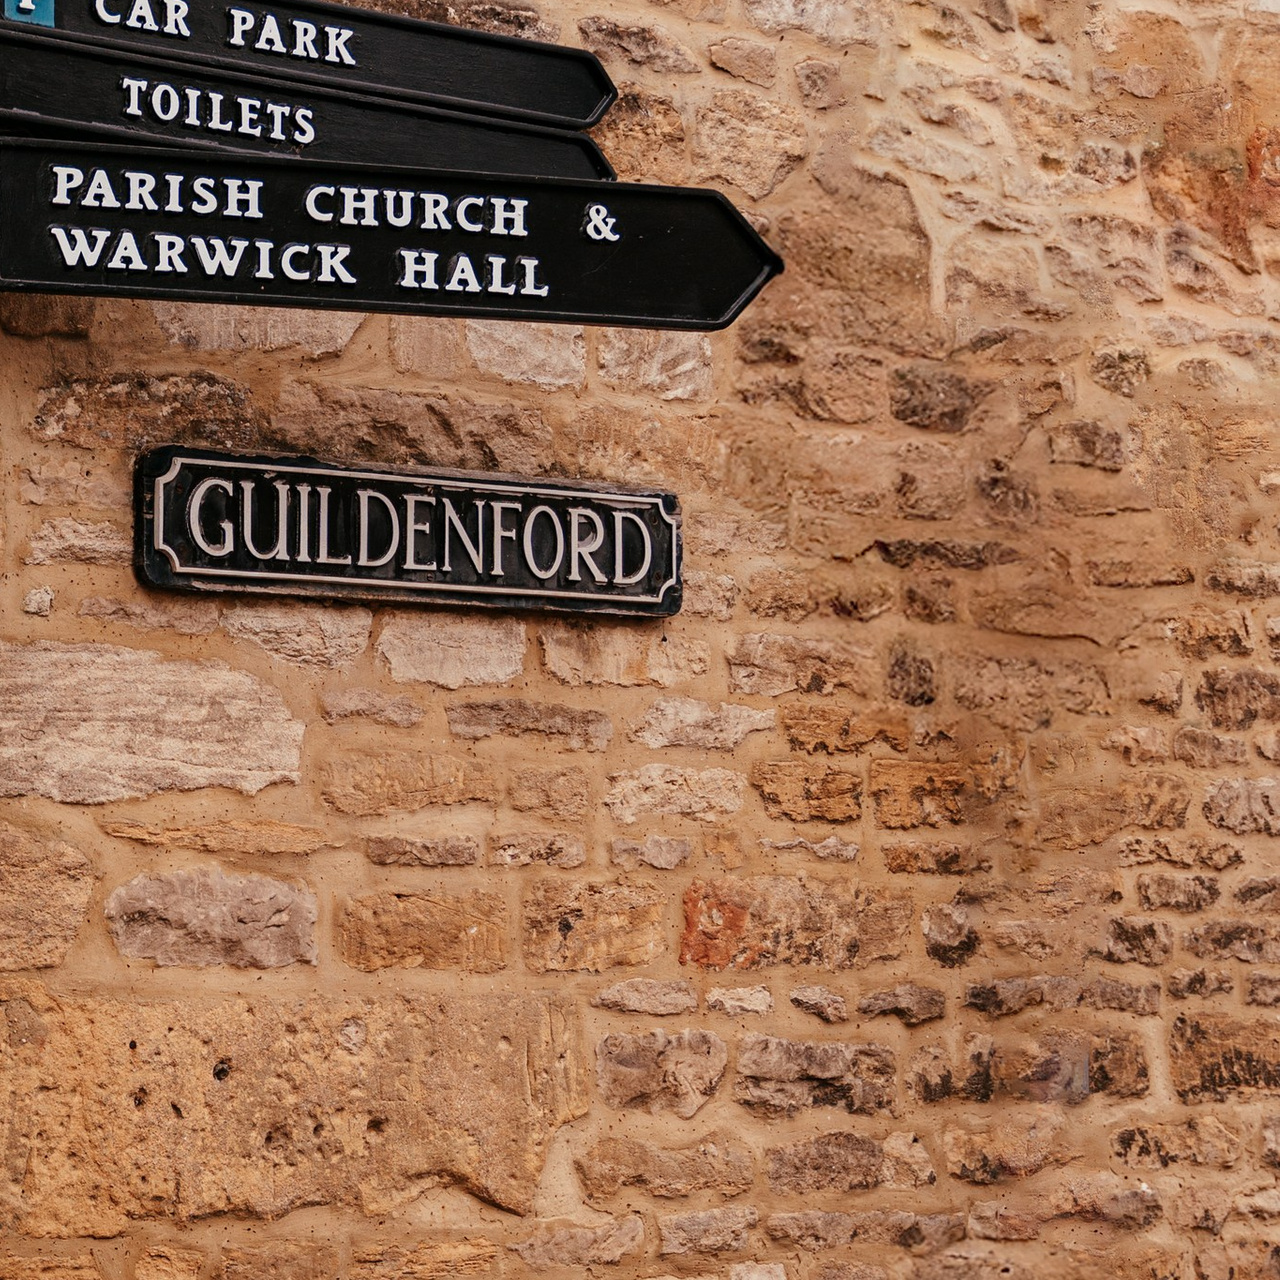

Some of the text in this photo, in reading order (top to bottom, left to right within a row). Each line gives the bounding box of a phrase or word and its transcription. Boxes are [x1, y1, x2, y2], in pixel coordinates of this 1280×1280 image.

[229, 8, 356, 66] PARK
[122, 77, 315, 144] TOILETS
[52, 166, 620, 242] PARISH CHURCH &
[50, 227, 549, 297] WARWICK HALL
[190, 478, 652, 587] GUILDENFORD
